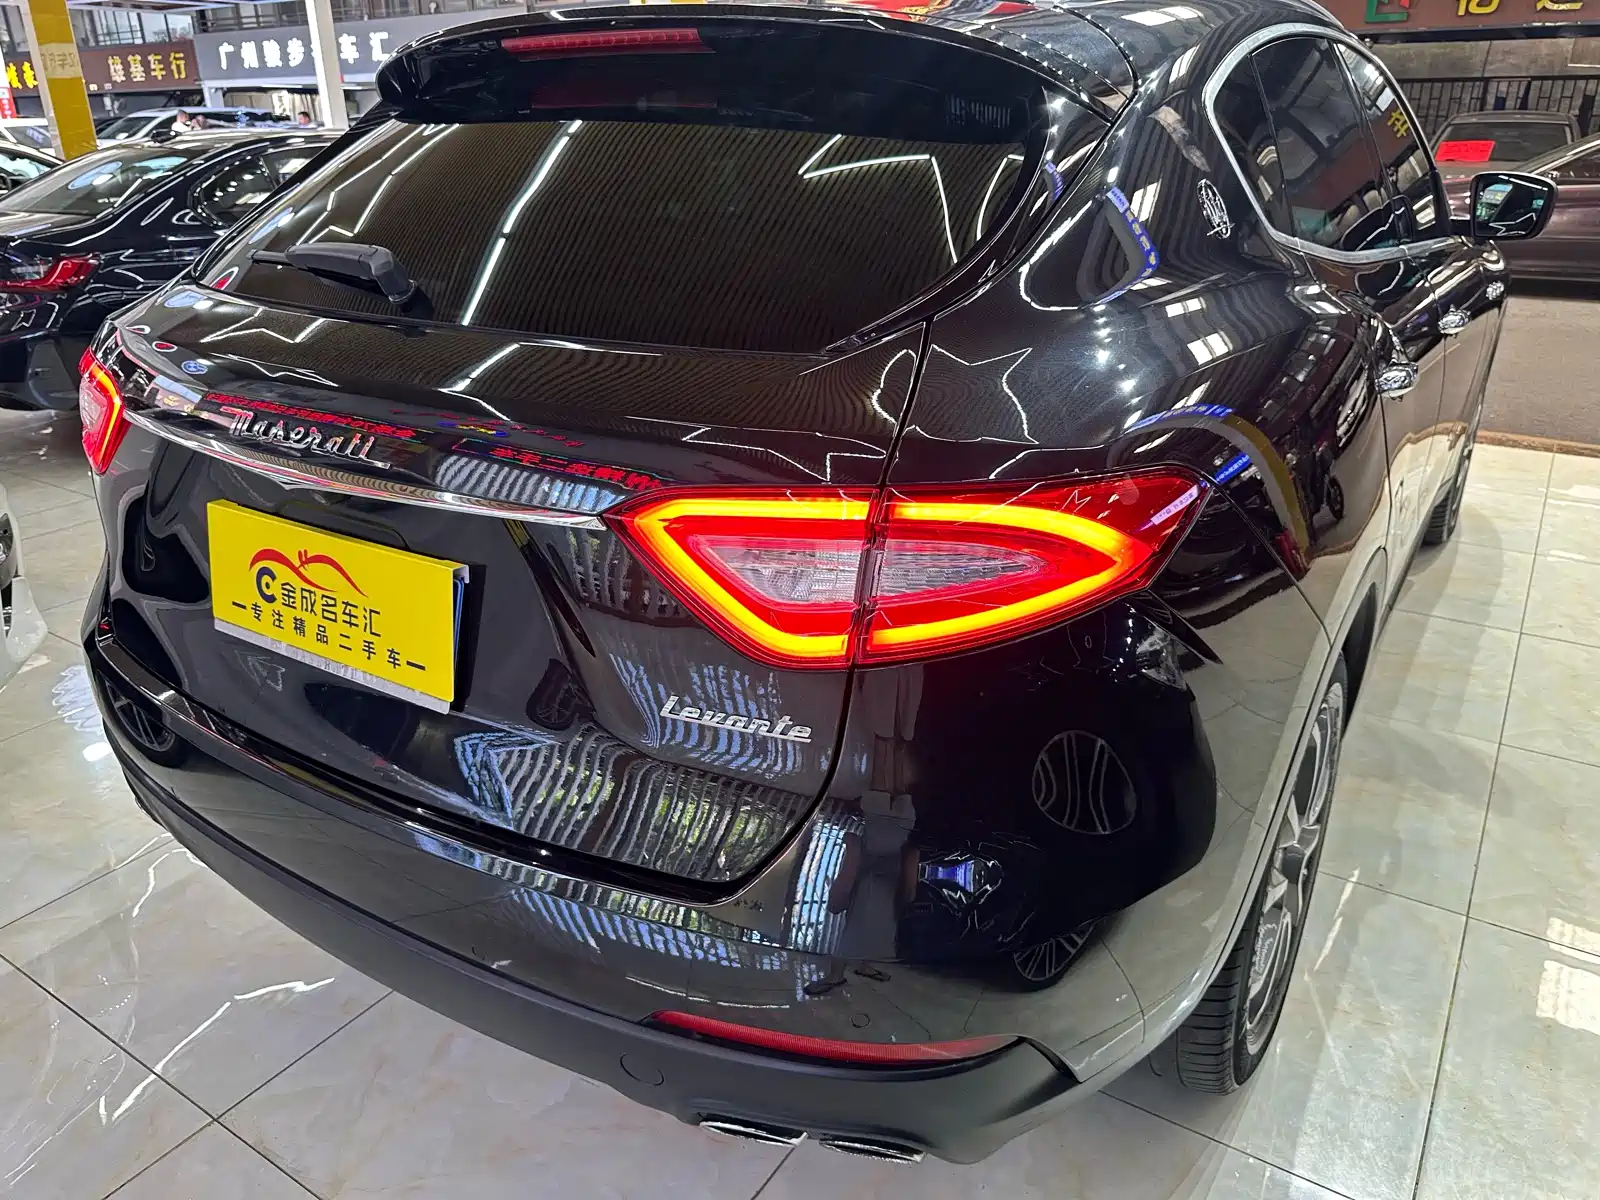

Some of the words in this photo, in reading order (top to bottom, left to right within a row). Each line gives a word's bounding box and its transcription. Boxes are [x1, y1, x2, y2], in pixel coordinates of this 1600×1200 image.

[220, 406, 391, 469] Maserati
[280, 581, 382, 638] 金成名车汇
[659, 694, 813, 743] Levante
